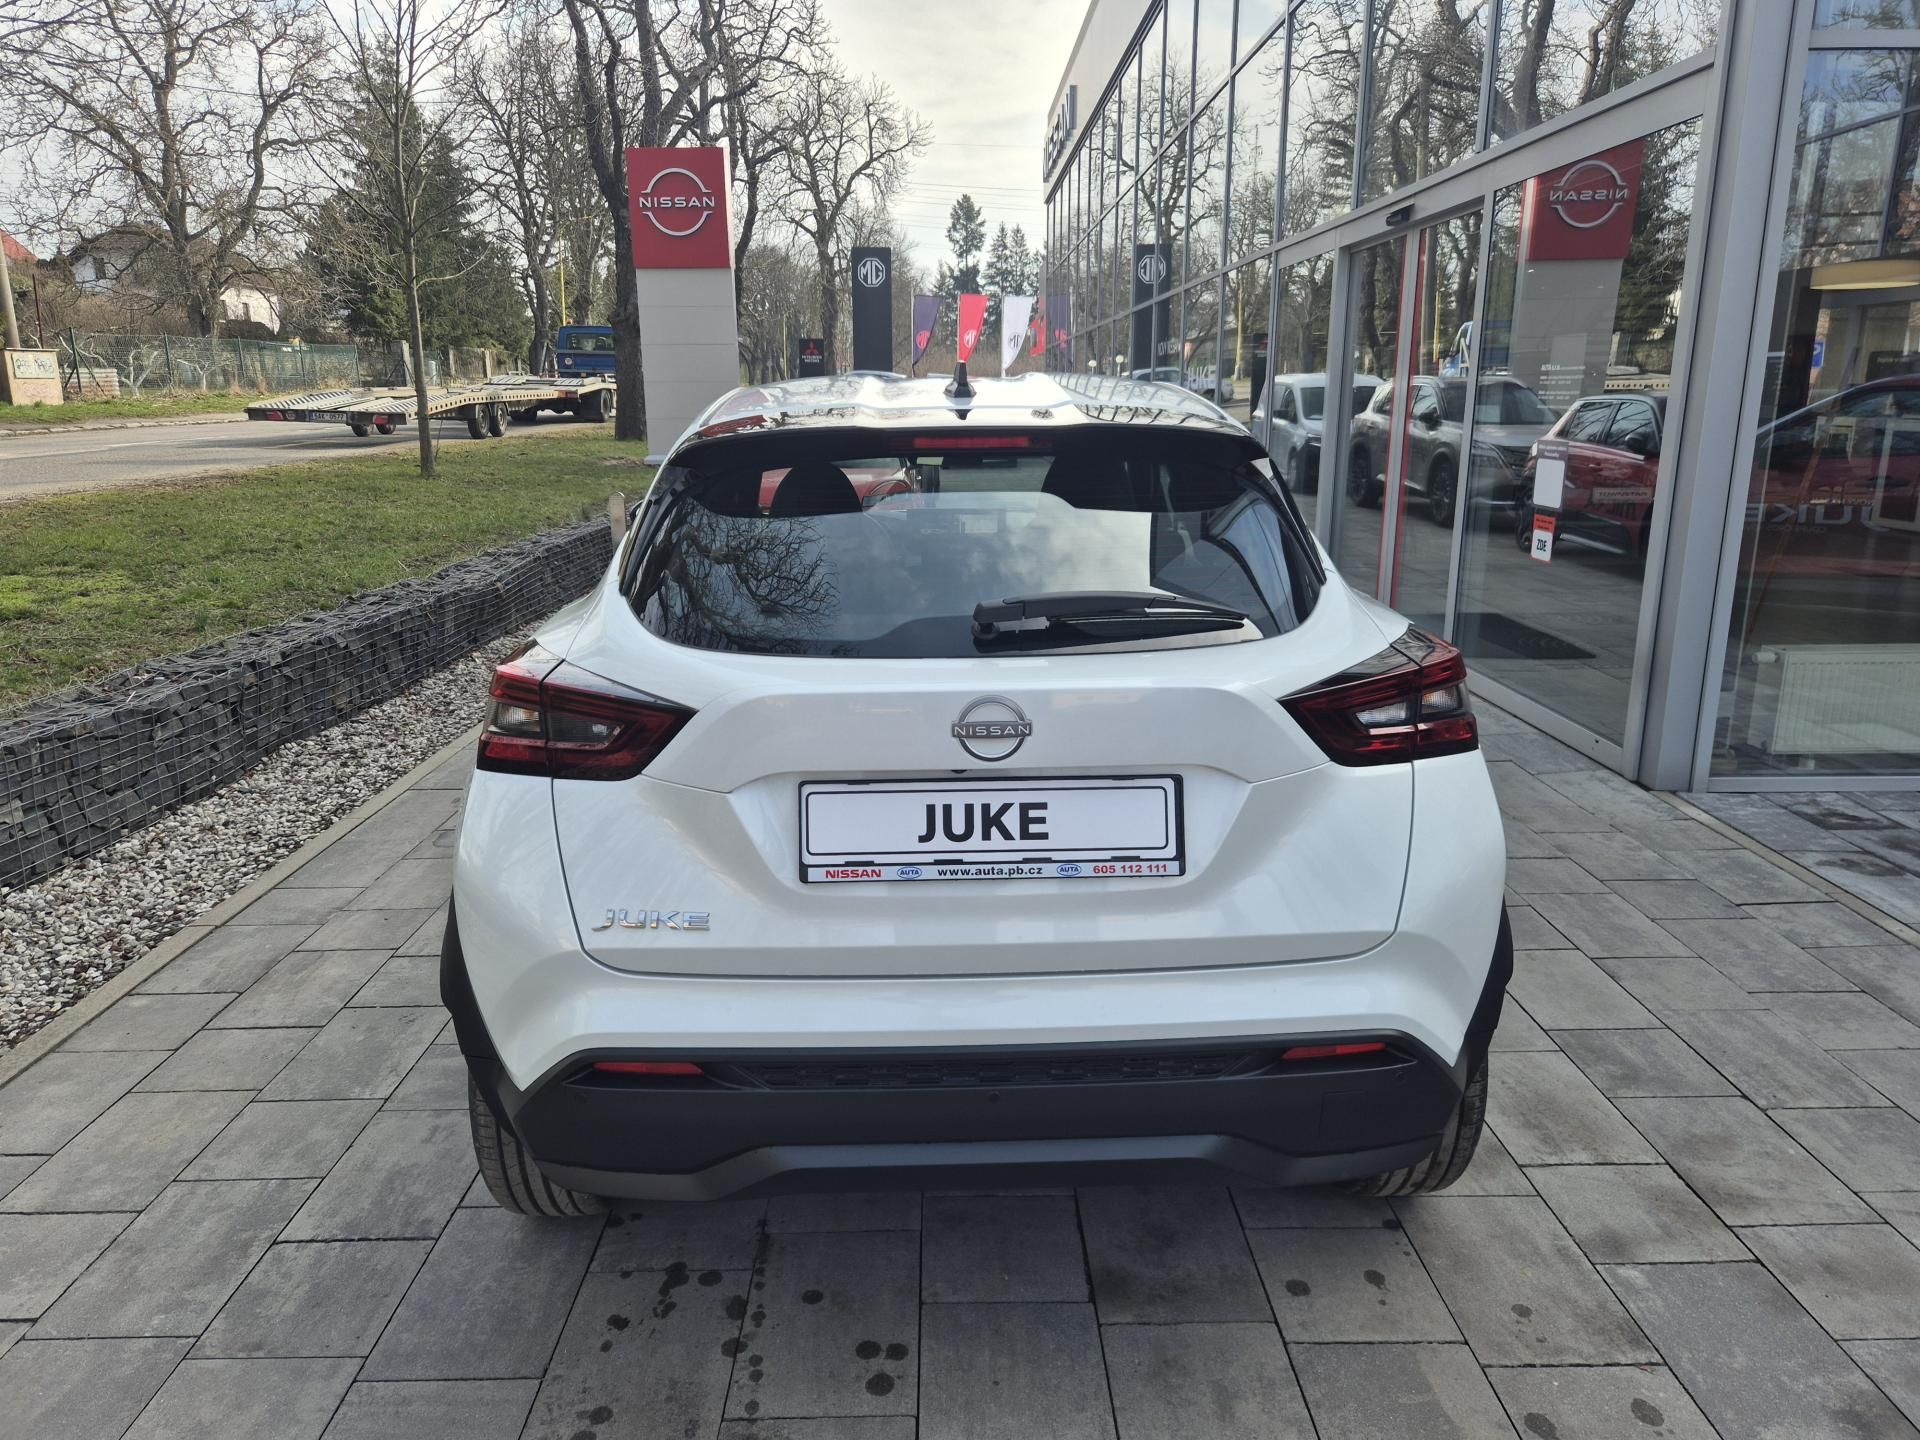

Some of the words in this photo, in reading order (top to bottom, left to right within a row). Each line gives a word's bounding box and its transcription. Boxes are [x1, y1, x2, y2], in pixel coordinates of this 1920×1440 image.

[639, 196, 715, 208] NISSAN
[861, 260, 883, 285] MG
[1536, 538, 1547, 552] ZDE
[954, 725, 1030, 736] NISSAN
[918, 802, 1049, 843] JUKE
[825, 869, 882, 879] NISSAN
[937, 866, 1043, 877] www.auta.pb.cz
[1093, 865, 1116, 874] 605
[1121, 864, 1143, 873] 112
[1146, 864, 1167, 873] 111
[592, 909, 710, 932] JUKE
